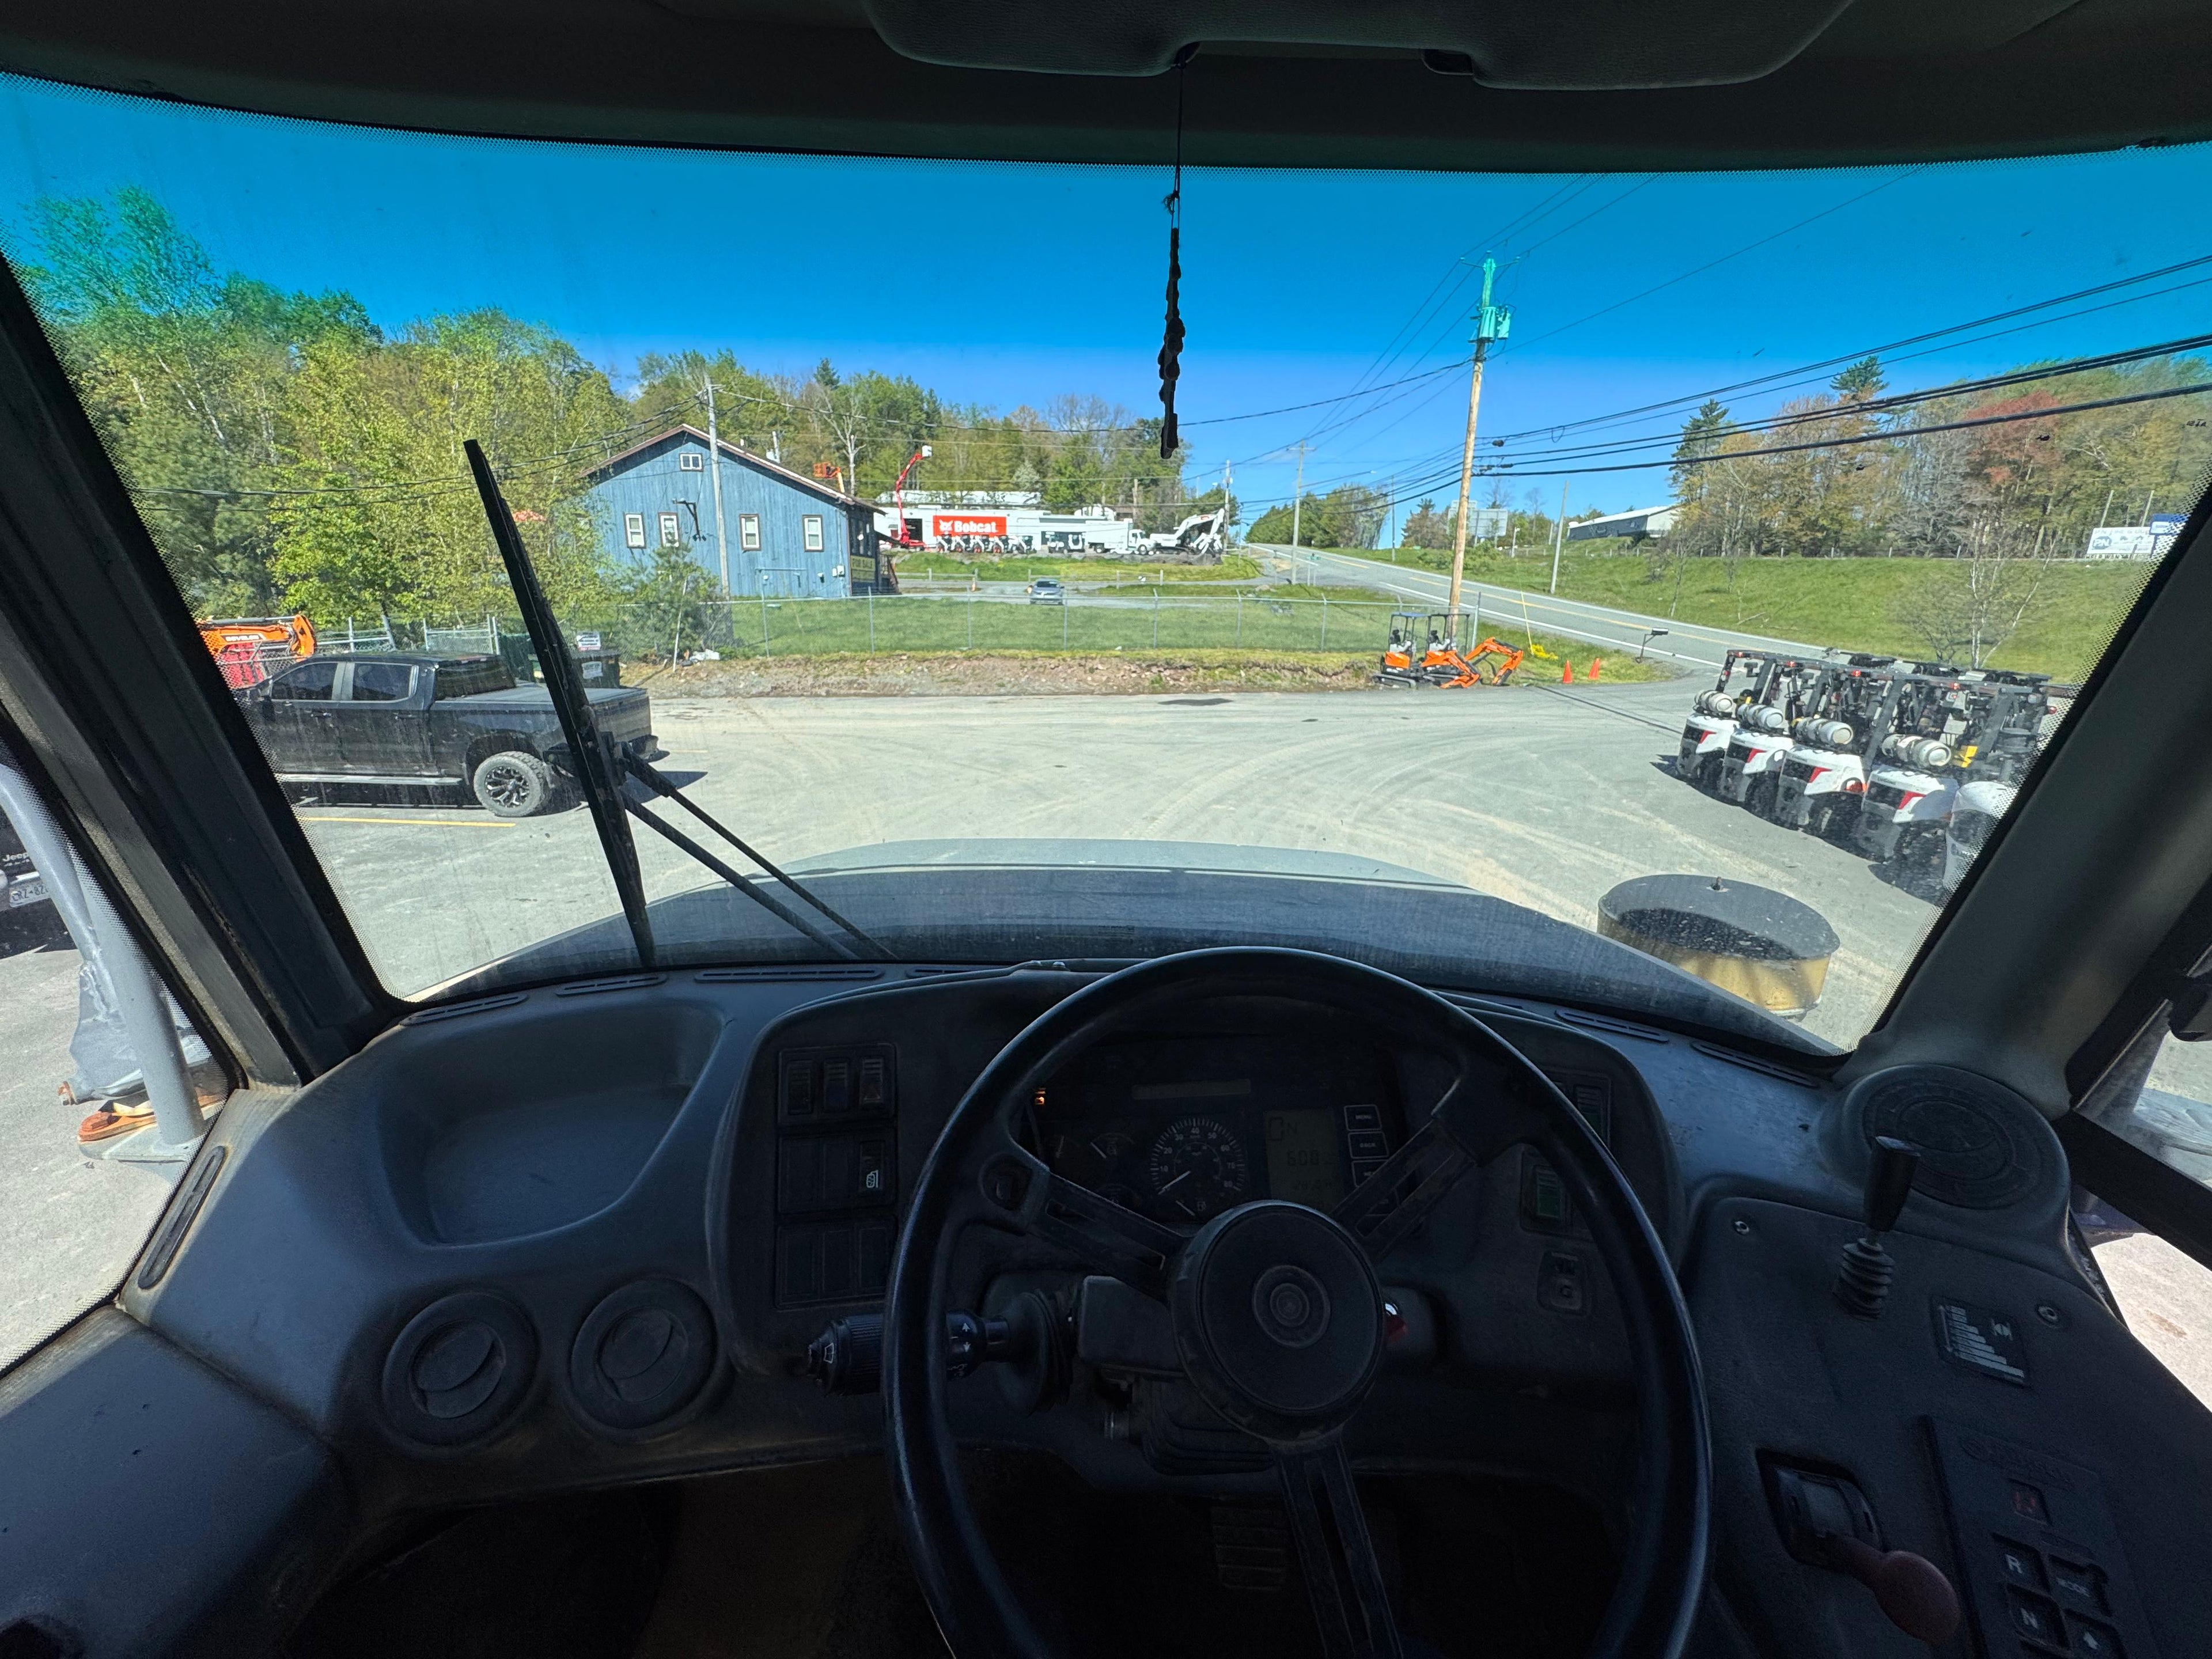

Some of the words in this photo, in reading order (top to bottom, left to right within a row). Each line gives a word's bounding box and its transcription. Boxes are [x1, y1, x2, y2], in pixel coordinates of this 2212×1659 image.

[954, 520, 997, 533] Bobcat
[2093, 538, 2109, 546] PN
[2, 852, 29, 862] Jeep
[1175, 1133, 1184, 1141] 30
[1164, 1146, 1173, 1154] 20
[1160, 1165, 1169, 1173] 10
[2005, 1554, 2023, 1574] R
[2021, 1607, 2039, 1630] N
